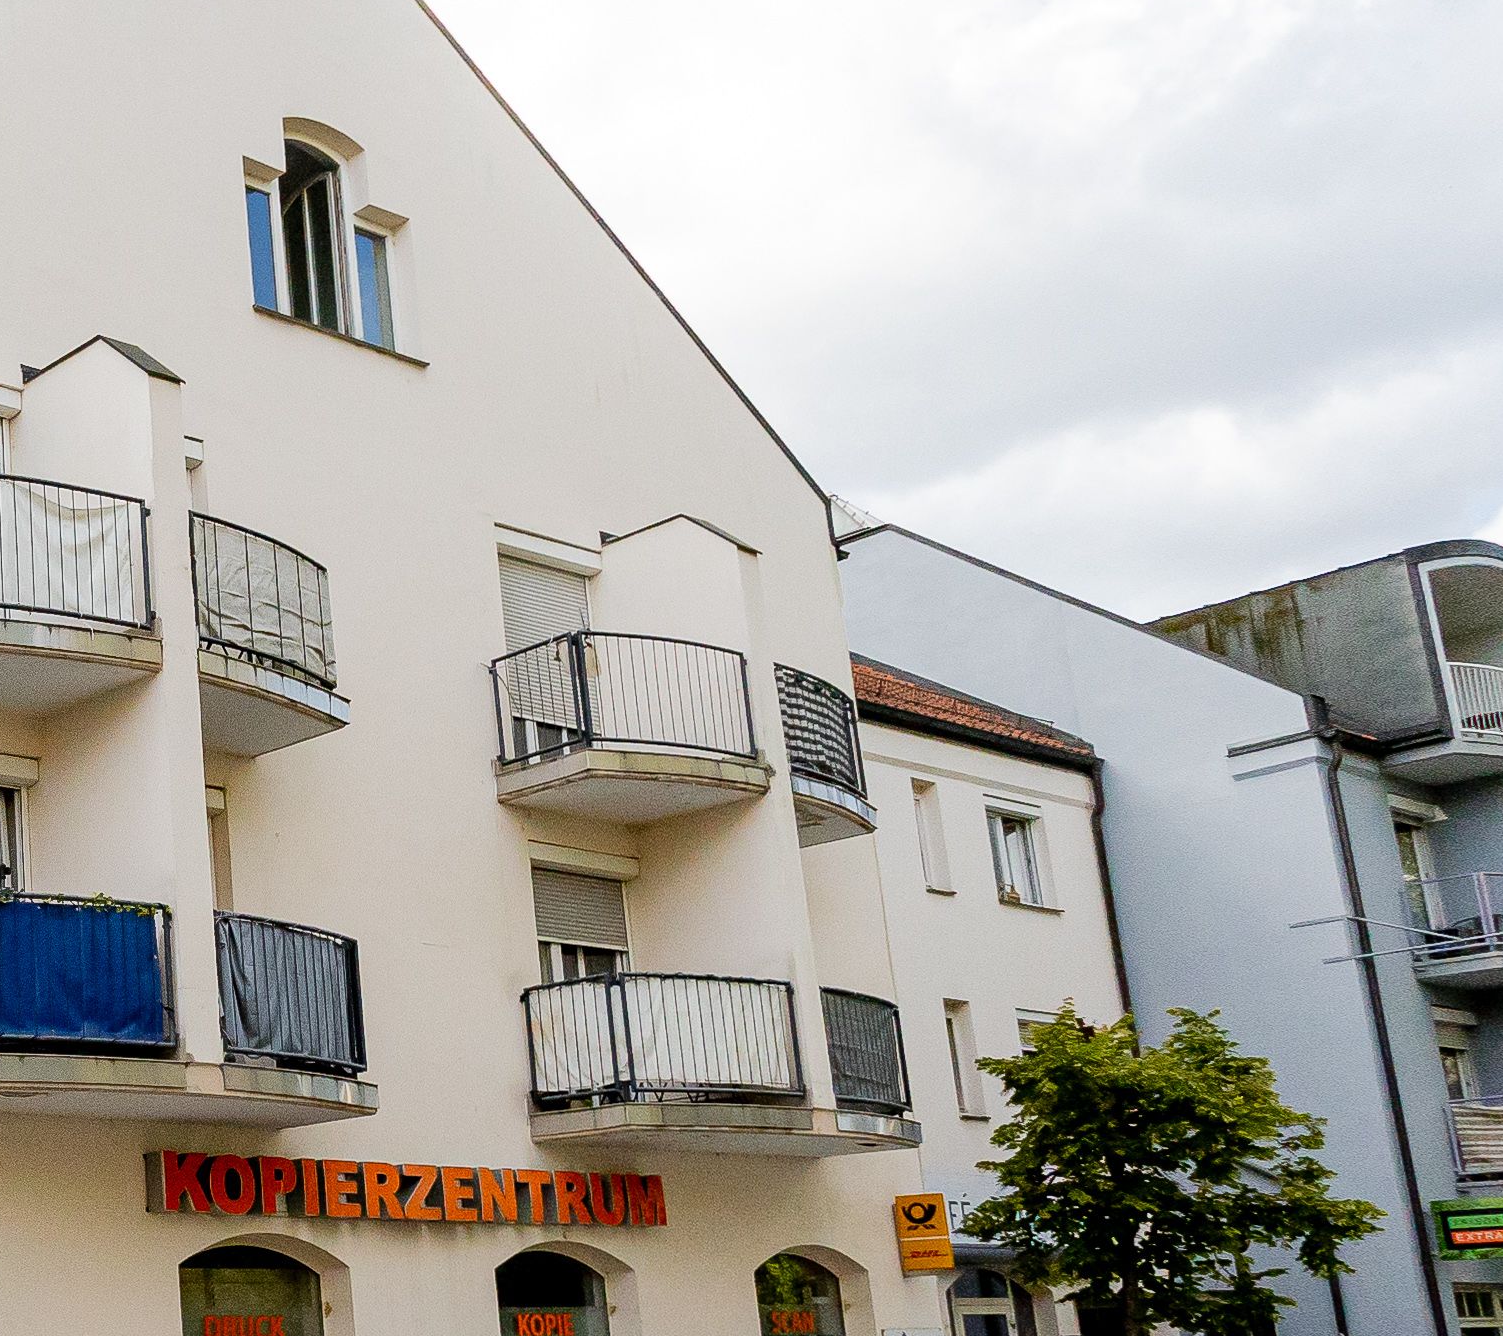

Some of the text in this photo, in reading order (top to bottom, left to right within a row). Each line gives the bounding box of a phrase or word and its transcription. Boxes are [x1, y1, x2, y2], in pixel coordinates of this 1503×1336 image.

[163, 1150, 668, 1226] KOPIERZENTRUM
[517, 1312, 575, 1336] KOPIE
[771, 1311, 815, 1333] SCAN
